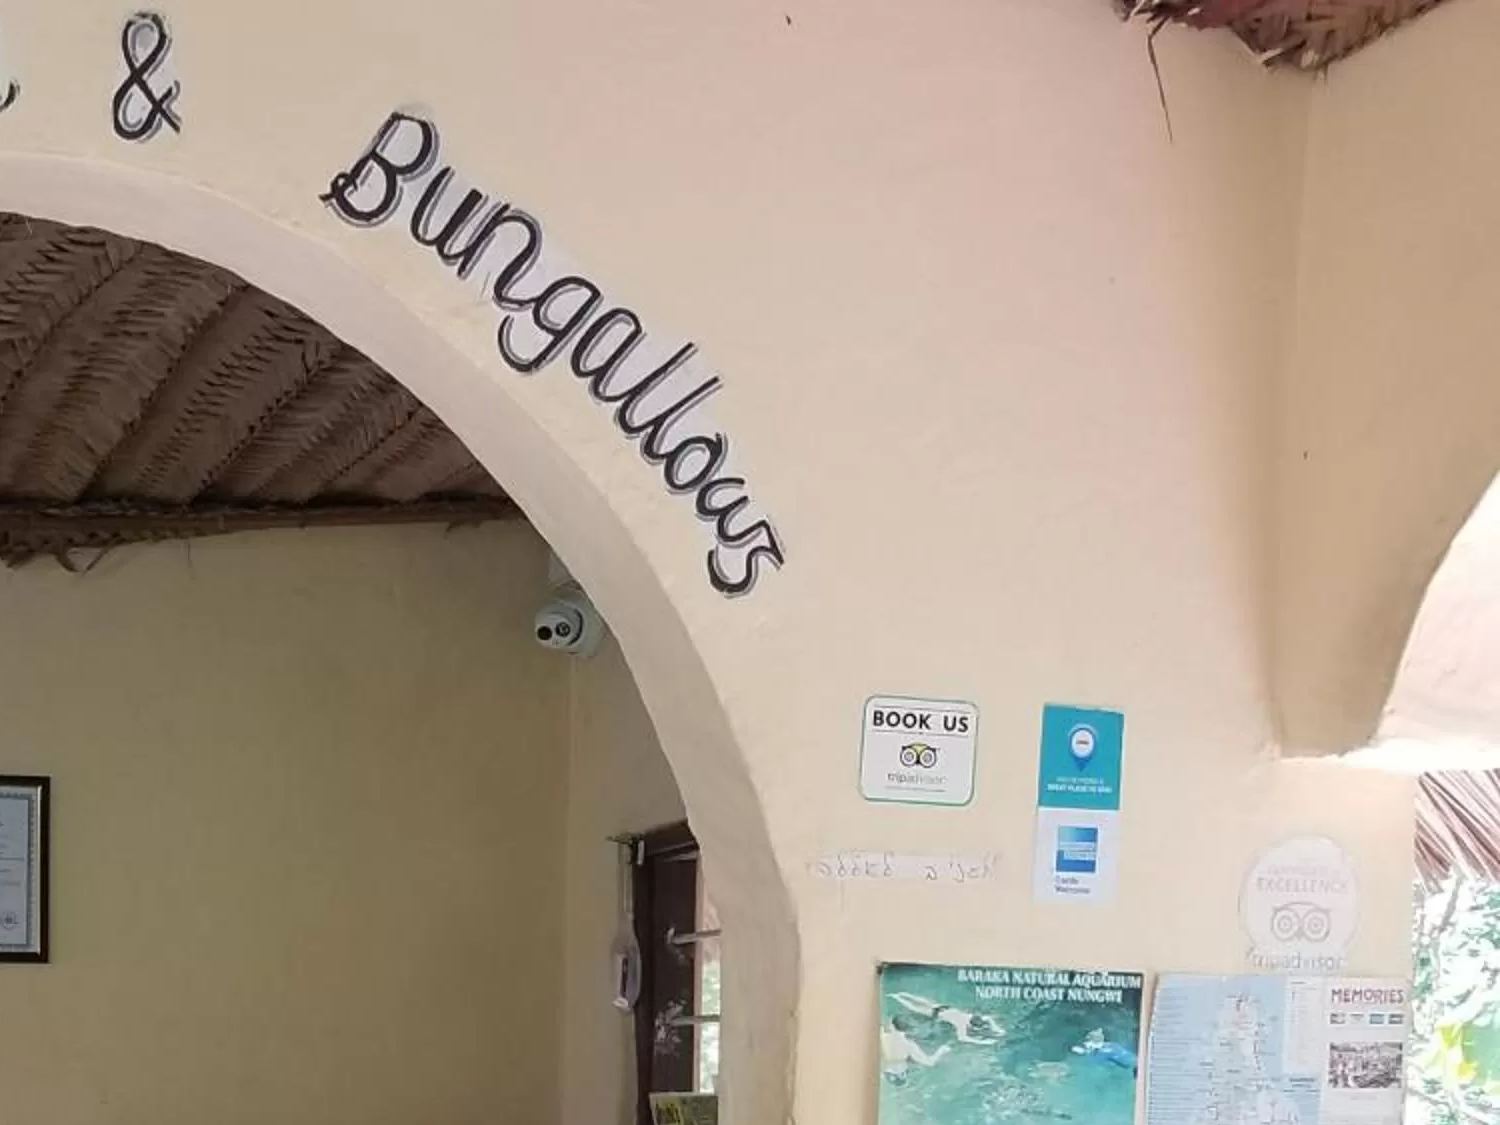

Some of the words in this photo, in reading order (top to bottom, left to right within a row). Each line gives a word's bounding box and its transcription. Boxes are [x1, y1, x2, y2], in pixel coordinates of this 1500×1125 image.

[112, 11, 182, 141] &
[320, 109, 784, 598] Bungallows
[873, 710, 932, 730] BOOK
[943, 715, 969, 733] US
[957, 969, 1010, 984] BARAKA
[1011, 971, 1071, 986] NATURAL
[1073, 973, 1142, 988] AQUARIUM
[975, 986, 1021, 1000] NORTH
[1023, 987, 1066, 1001] COAST
[1067, 989, 1123, 1003] NUNGWI
[1331, 988, 1404, 1004] MEMORIES
